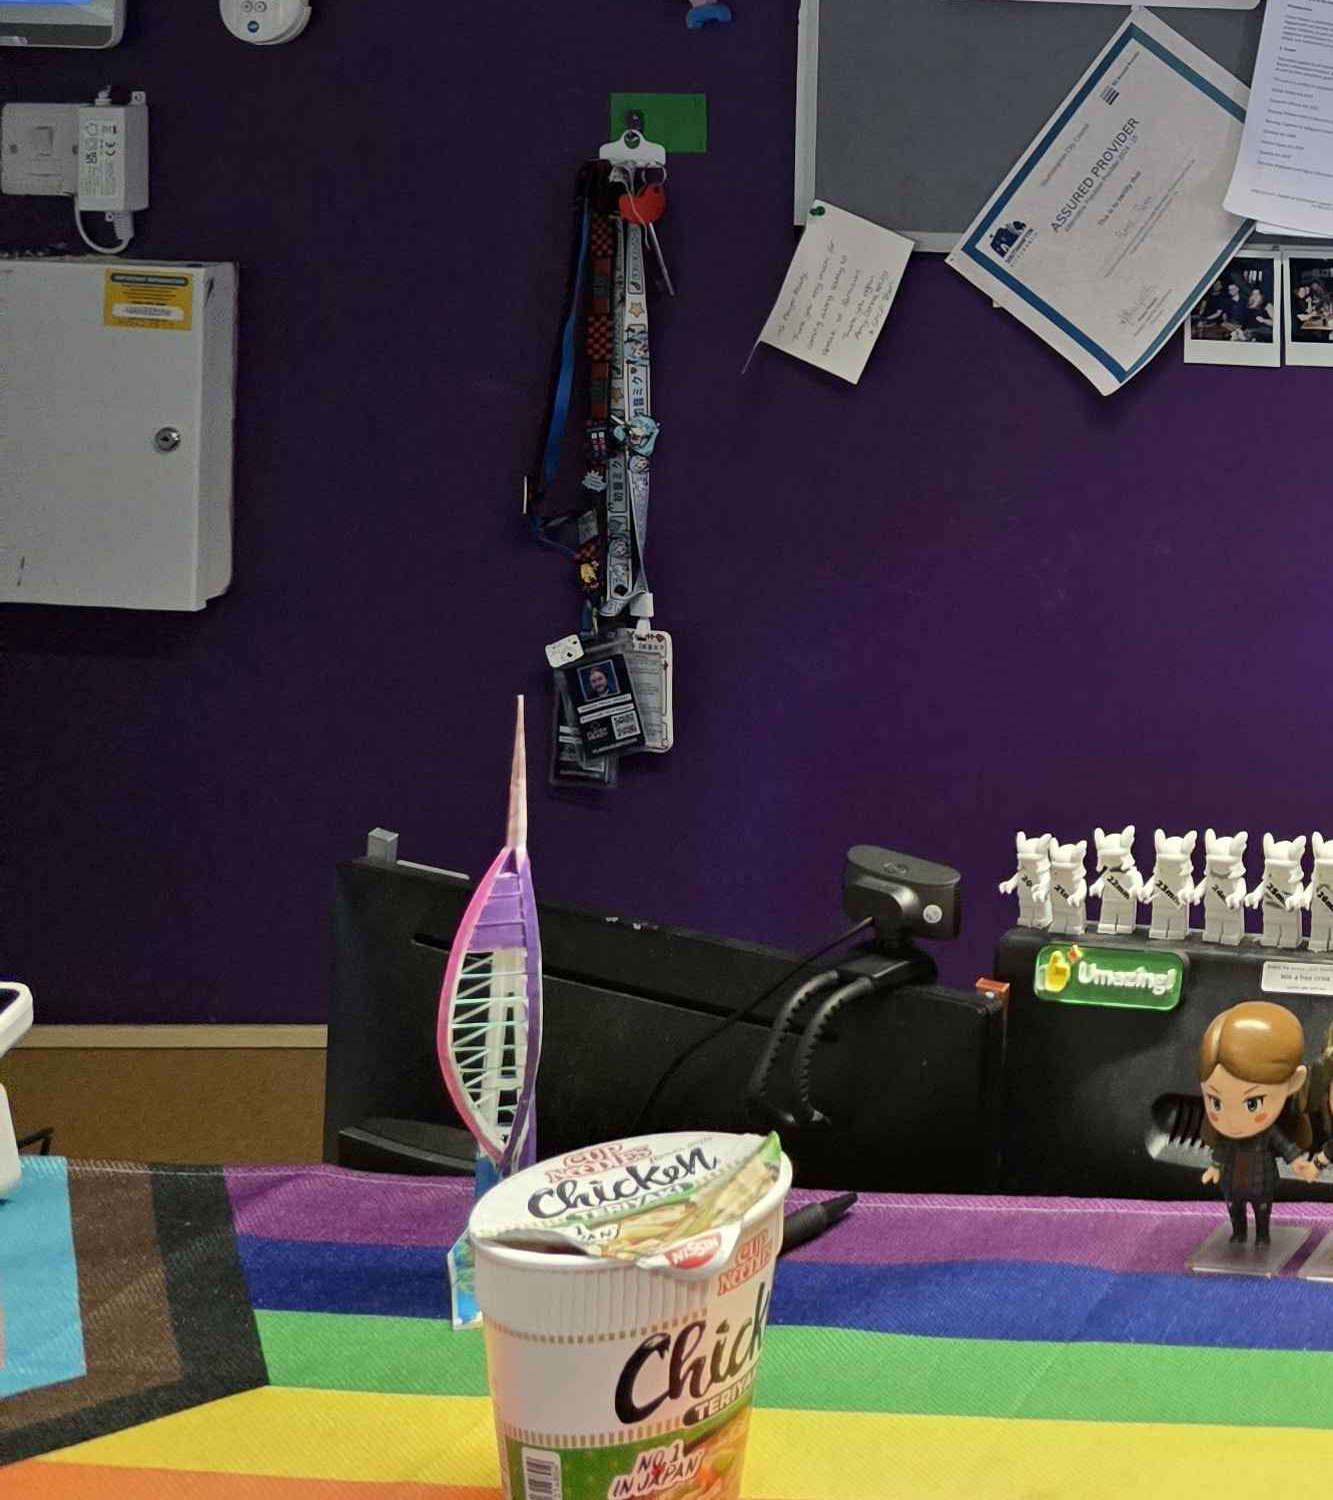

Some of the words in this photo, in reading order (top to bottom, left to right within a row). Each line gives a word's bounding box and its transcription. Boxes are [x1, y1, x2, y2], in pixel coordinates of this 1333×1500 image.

[1051, 177, 1096, 234] ASSURED
[1091, 116, 1141, 178] PROVIDER
[1078, 961, 1177, 996] Umazing!
[528, 1146, 721, 1219] Chicken
[671, 1236, 719, 1267] NISSIN
[638, 1441, 683, 1474] NO.1
[613, 1479, 633, 1496] IN
[636, 1460, 698, 1494] JAPAN
